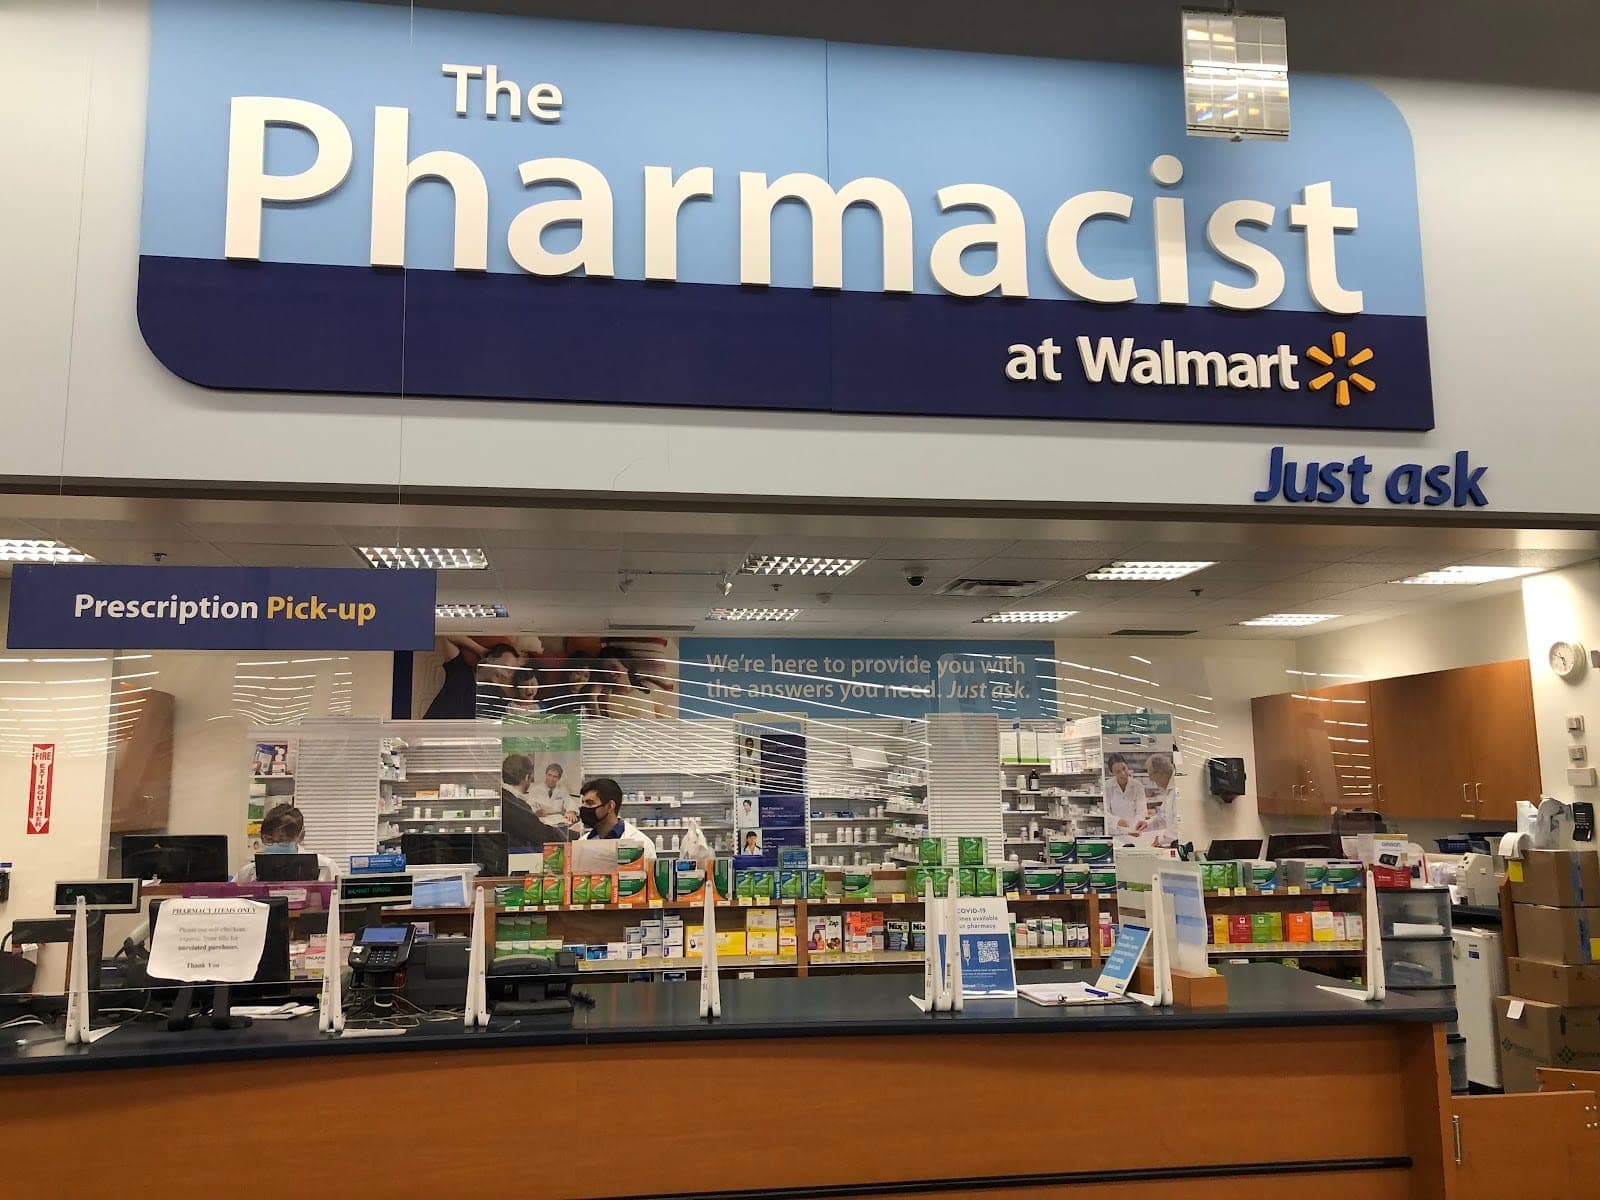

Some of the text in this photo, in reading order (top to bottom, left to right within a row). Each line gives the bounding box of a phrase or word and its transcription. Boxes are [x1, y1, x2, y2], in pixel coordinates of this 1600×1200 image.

[441, 63, 564, 122] The
[223, 95, 1365, 314] Pharmacist
[1005, 335, 1301, 392] at Walmart
[1254, 446, 1489, 513] Just ask
[73, 593, 377, 627] Prescription Pick-up
[706, 653, 1025, 678] We're here to provide you with
[706, 679, 1030, 703] the answers you need. Just ask.
[35, 751, 51, 761] FIRE
[35, 763, 46, 827] EXTINGUISHER
